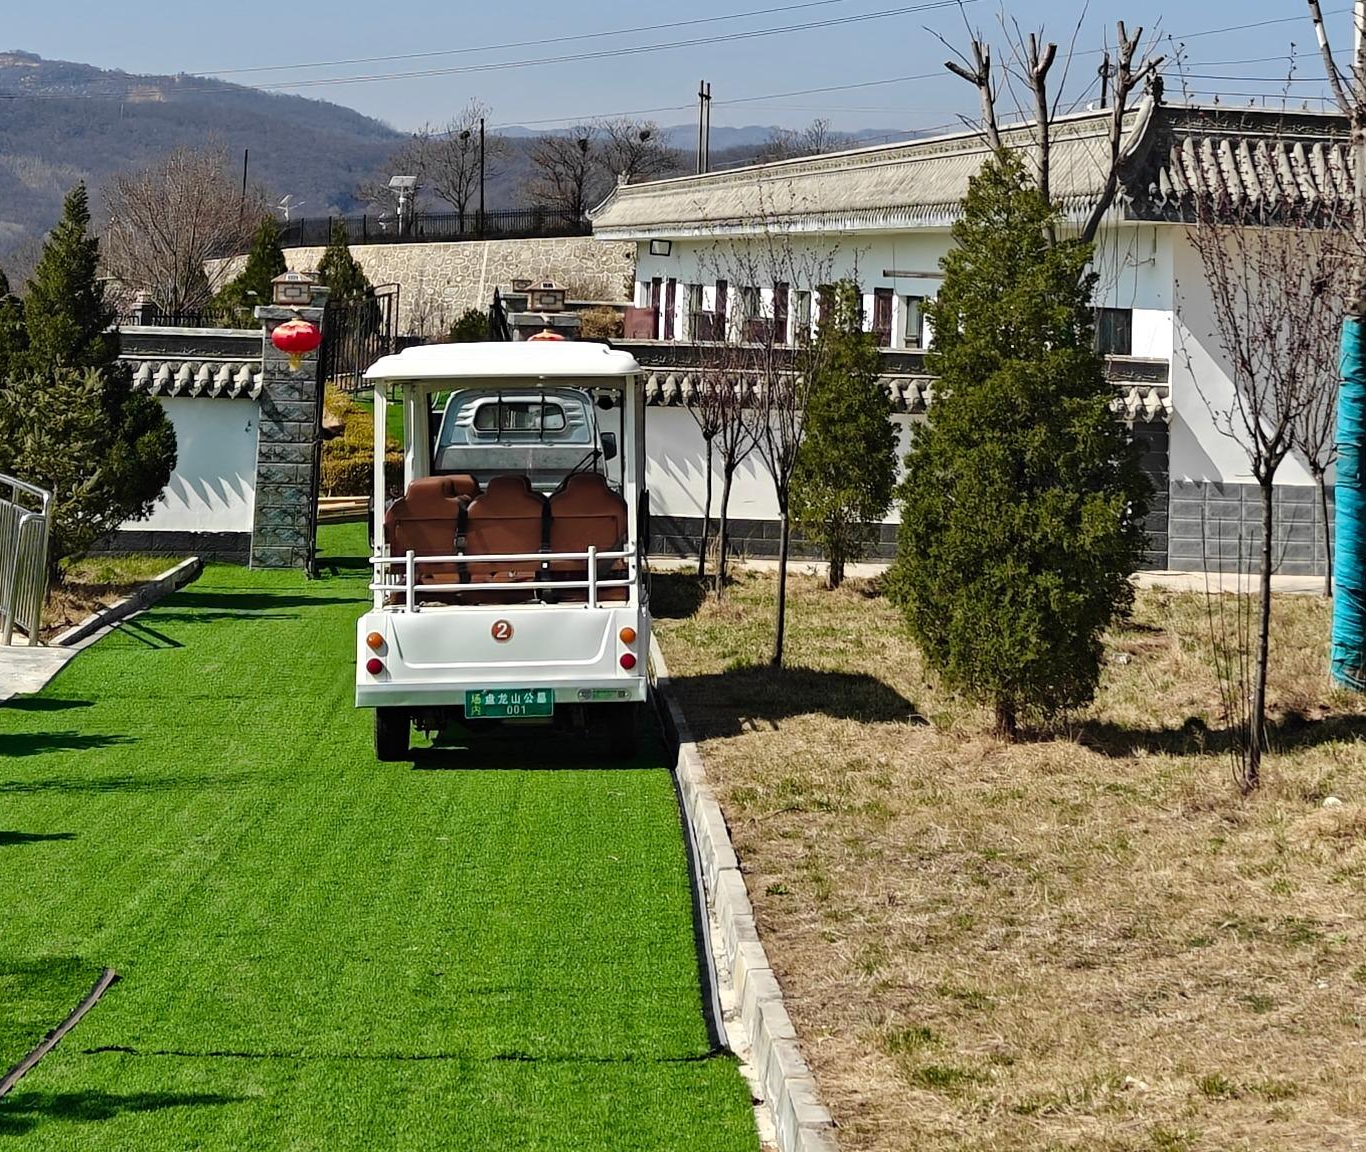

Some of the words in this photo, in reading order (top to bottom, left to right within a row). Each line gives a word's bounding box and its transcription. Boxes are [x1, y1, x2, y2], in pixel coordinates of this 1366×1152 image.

[496, 622, 508, 638] 2
[484, 691, 547, 705] 盘龙山公墓
[506, 705, 526, 715] 001
